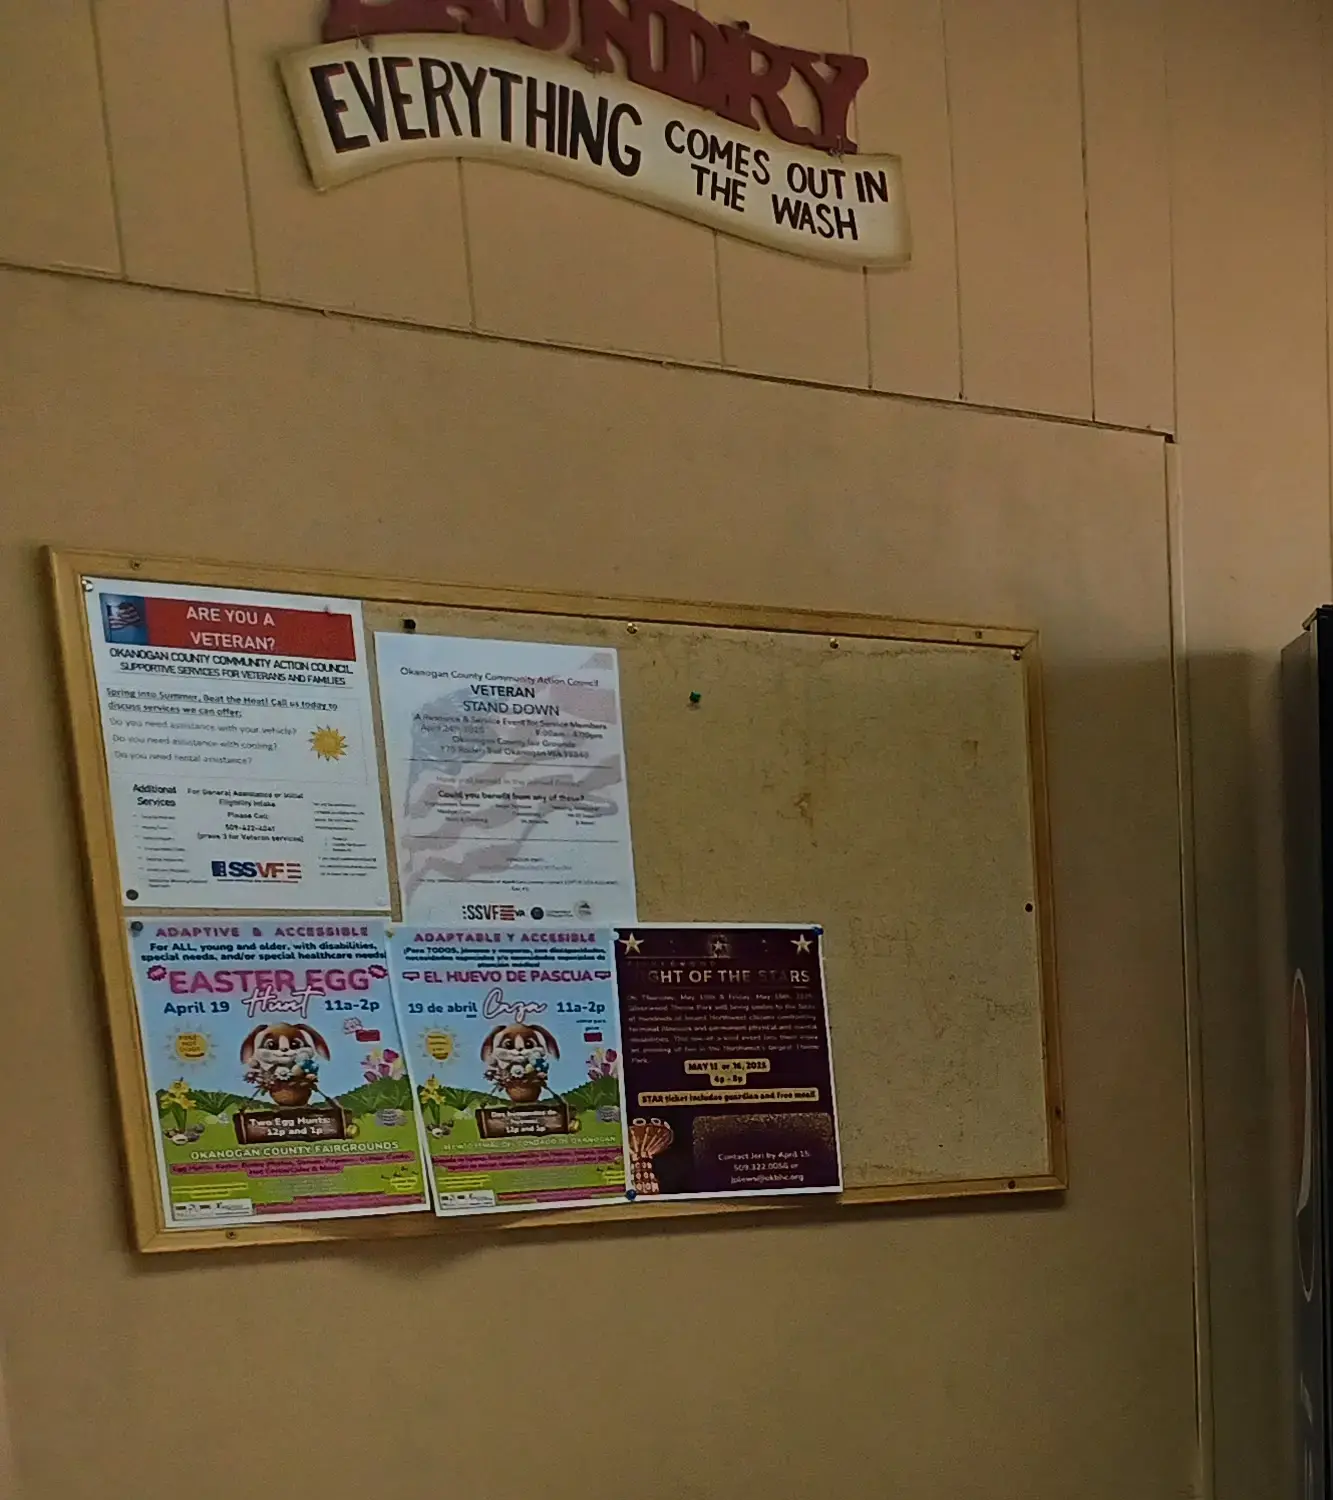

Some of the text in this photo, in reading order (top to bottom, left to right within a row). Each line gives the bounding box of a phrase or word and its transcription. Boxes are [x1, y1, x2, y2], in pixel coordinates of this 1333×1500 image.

[310, 57, 643, 177] EVERYTHING
[664, 120, 889, 203] COMES OUT IN
[691, 163, 859, 241] THE WASH
[186, 607, 276, 626] ARE YOU A
[189, 631, 276, 650] VETERAN?
[109, 647, 353, 675] OKANOGAN COUNTY COMMUNITY ACTION COUNCIL
[120, 662, 346, 686] SUPPORTIVE SERVICES FOR VETERANS AND FAMILIES
[400, 667, 449, 679] Okanogan
[451, 670, 483, 681] County
[485, 673, 536, 685] Community
[470, 684, 535, 698] VETERAN
[463, 700, 560, 716] STAND DOWN
[137, 797, 176, 807] Services
[228, 861, 285, 879] SSVF
[467, 905, 499, 920] SSVF
[156, 927, 240, 938] ADAPTIVE
[275, 927, 368, 937] ACCESSIBLE
[414, 933, 596, 943] ADAPTABLE Y ACCESIBLE
[150, 943, 168, 951] For
[200, 944, 233, 953] young
[236, 943, 255, 951] and
[293, 942, 316, 950] with
[141, 953, 180, 962] special
[221, 952, 255, 961] and/or
[259, 951, 295, 961] special
[298, 950, 352, 960] healthcare
[168, 968, 370, 994] EASTER EGG
[424, 970, 593, 983] EL HUEVO DE PASCUA
[689, 970, 712, 983] OF
[718, 970, 750, 983] THE
[758, 970, 810, 983] STARS
[164, 1001, 230, 1017] April 19
[242, 985, 326, 1019] Hunt
[325, 999, 380, 1015] 11a-2p
[408, 1002, 478, 1013] 19 de abril
[557, 1002, 605, 1014] 11a-2p
[249, 1118, 273, 1127] Two
[275, 1117, 296, 1127] Egg
[267, 1126, 323, 1137] 12p and 1p
[191, 1141, 399, 1160] OKANOGAN COUNTY FAIRGROUNDS
